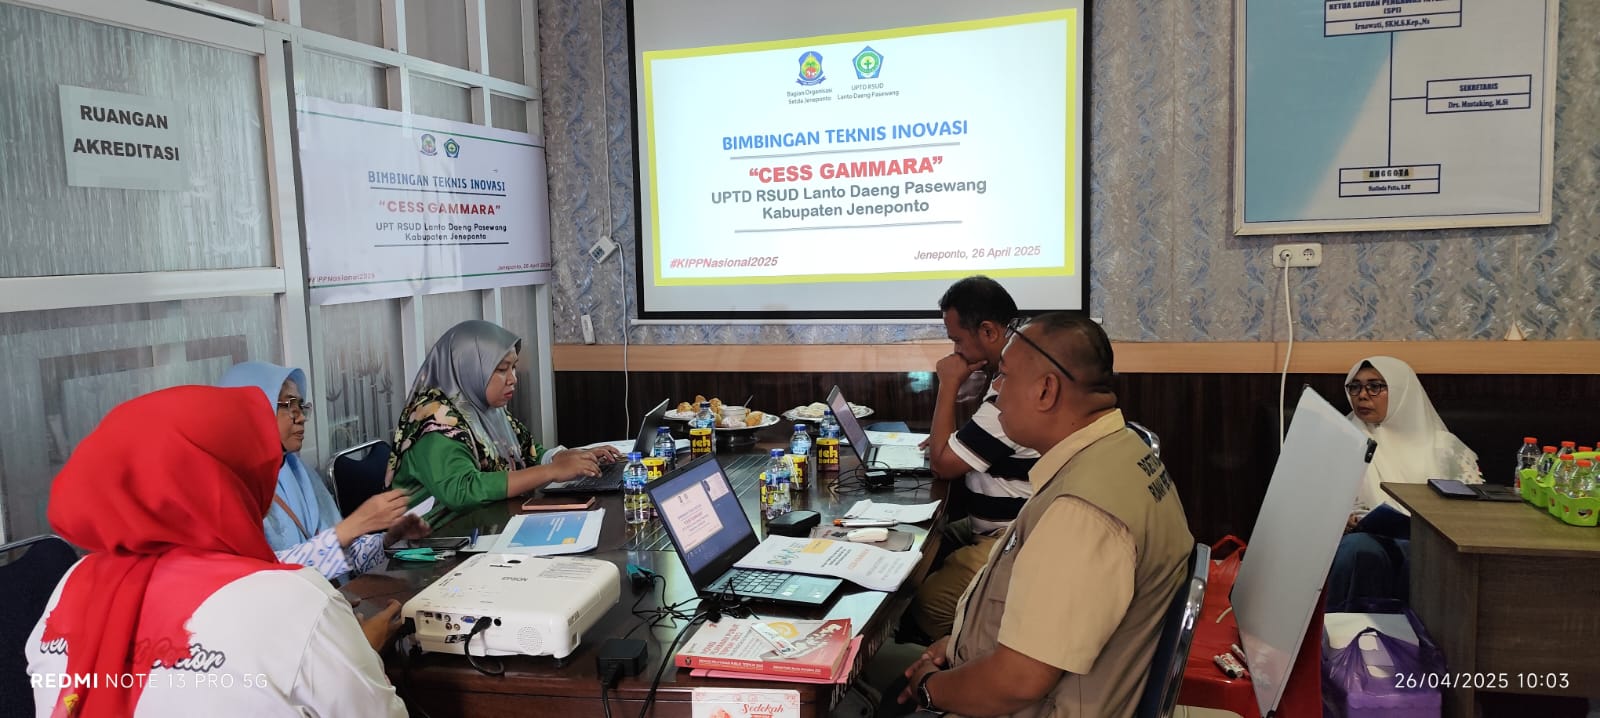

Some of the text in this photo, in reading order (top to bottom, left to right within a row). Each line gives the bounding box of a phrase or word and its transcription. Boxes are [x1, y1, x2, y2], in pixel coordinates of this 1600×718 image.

[80, 105, 168, 130] RUANGAN
[722, 120, 968, 150] BIMBINGAN TEKNIS INOVASI
[73, 138, 180, 161] AKREDITASI
[1369, 169, 1409, 177] ANGGOTA
[368, 170, 505, 191] BIMBINGAN TEKNIS INOVASI
[712, 178, 987, 204] UPTD RSUD Lanto Daeng Pasewang
[762, 200, 930, 220] Kabupaten Jeneponto
[376, 222, 394, 231] UPT
[398, 222, 421, 231] RSUD
[448, 223, 472, 232] Daeng
[474, 223, 507, 232] Pasewang
[405, 232, 487, 241] Kabupaten Jeneponto
[914, 245, 1041, 261] Jeneponto, 26 April 2025
[670, 256, 779, 269] #KIPPNasional2025
[692, 438, 711, 447] teh
[819, 446, 838, 457] teh
[648, 466, 662, 477] eh
